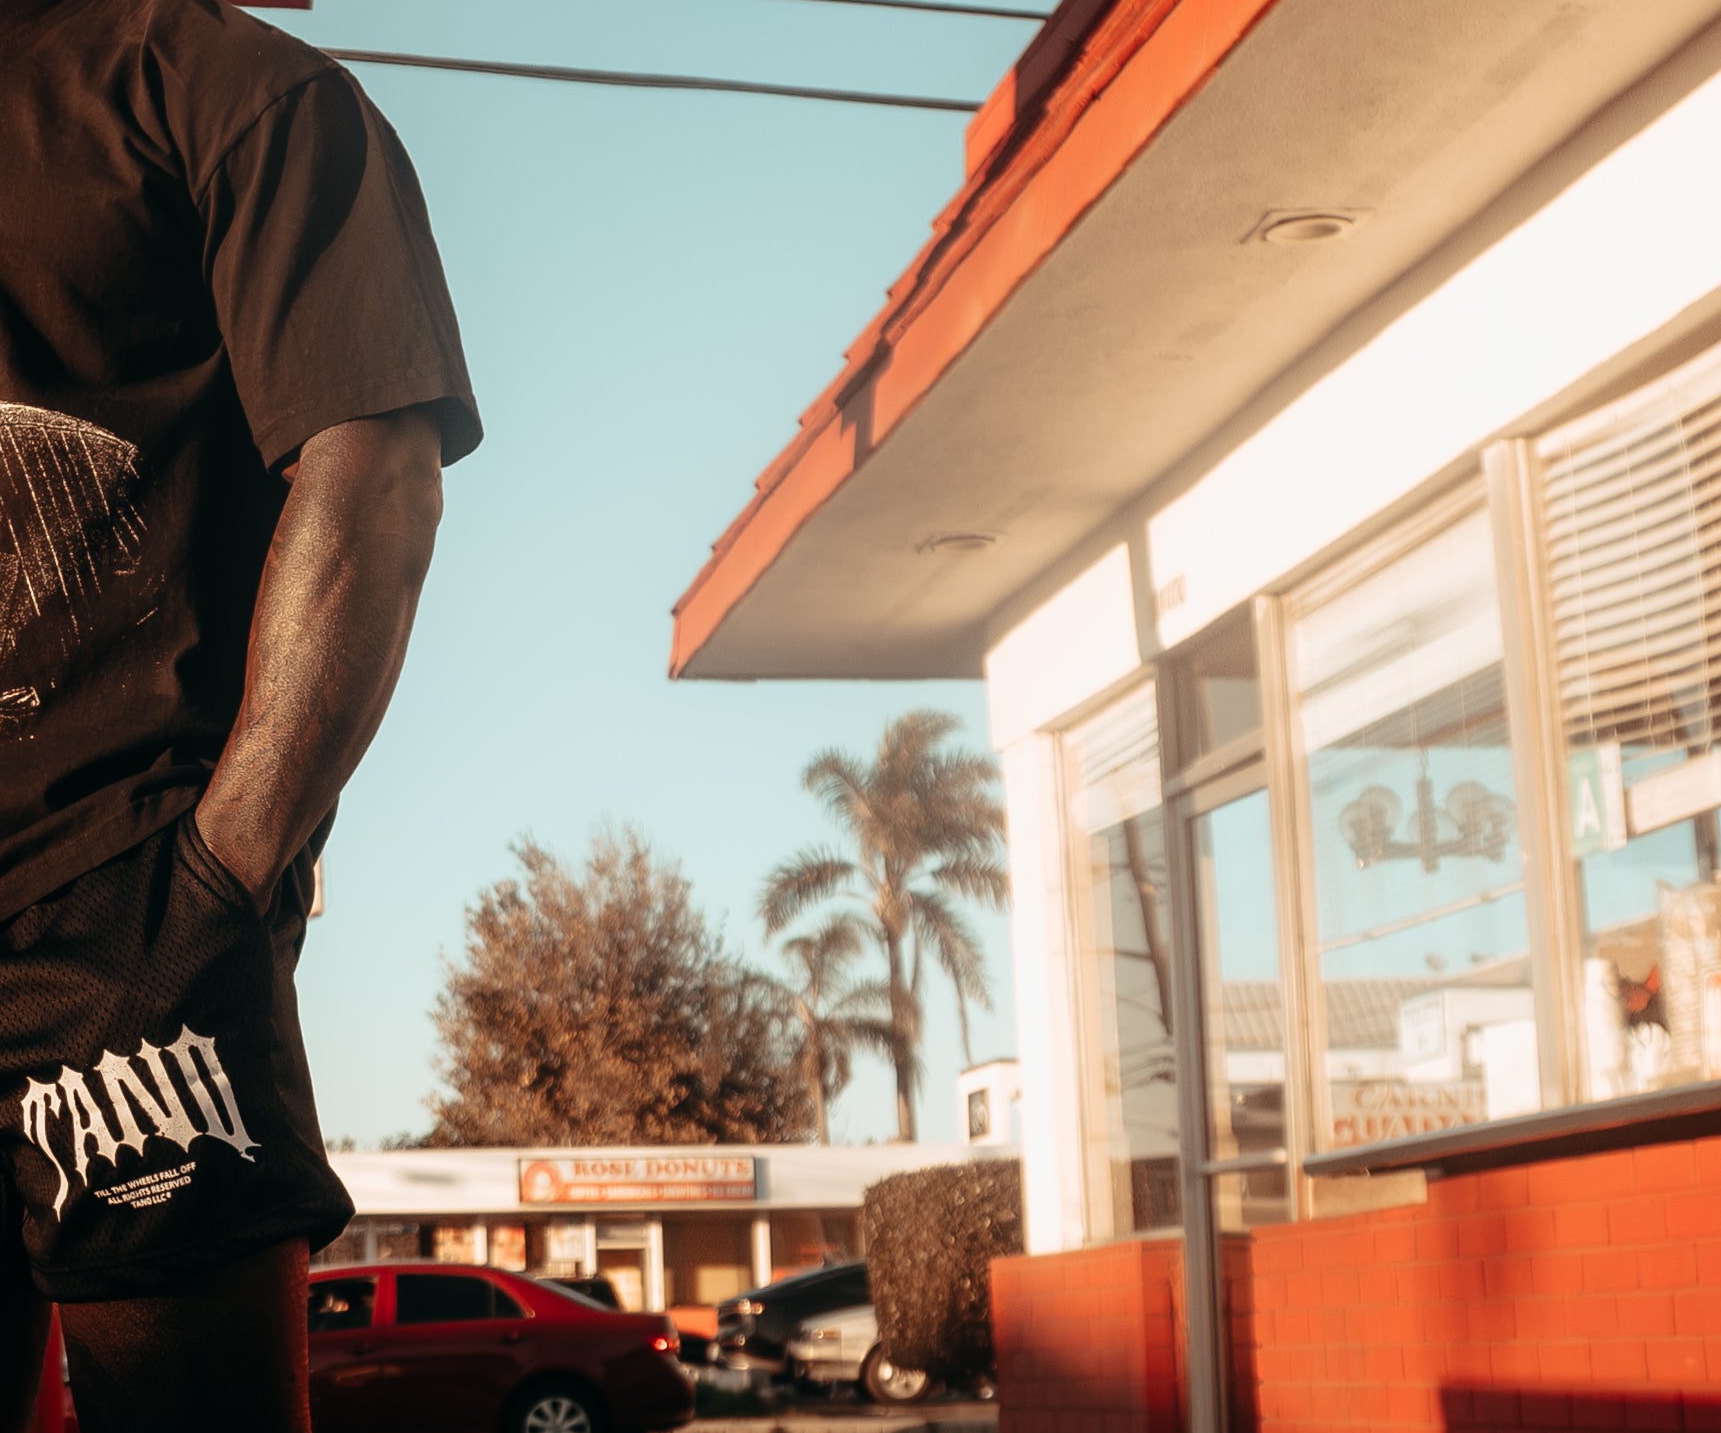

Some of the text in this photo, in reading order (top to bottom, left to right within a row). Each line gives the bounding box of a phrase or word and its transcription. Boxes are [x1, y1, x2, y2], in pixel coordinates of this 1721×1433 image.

[110, 1184, 128, 1195] THE
[127, 1173, 159, 1189] WHEELS
[160, 1168, 180, 1180] FALL
[180, 1161, 196, 1174] OFF
[646, 1157, 750, 1176] DONUTS
[107, 1175, 192, 1205] ALL RIGHTS RESERVED
